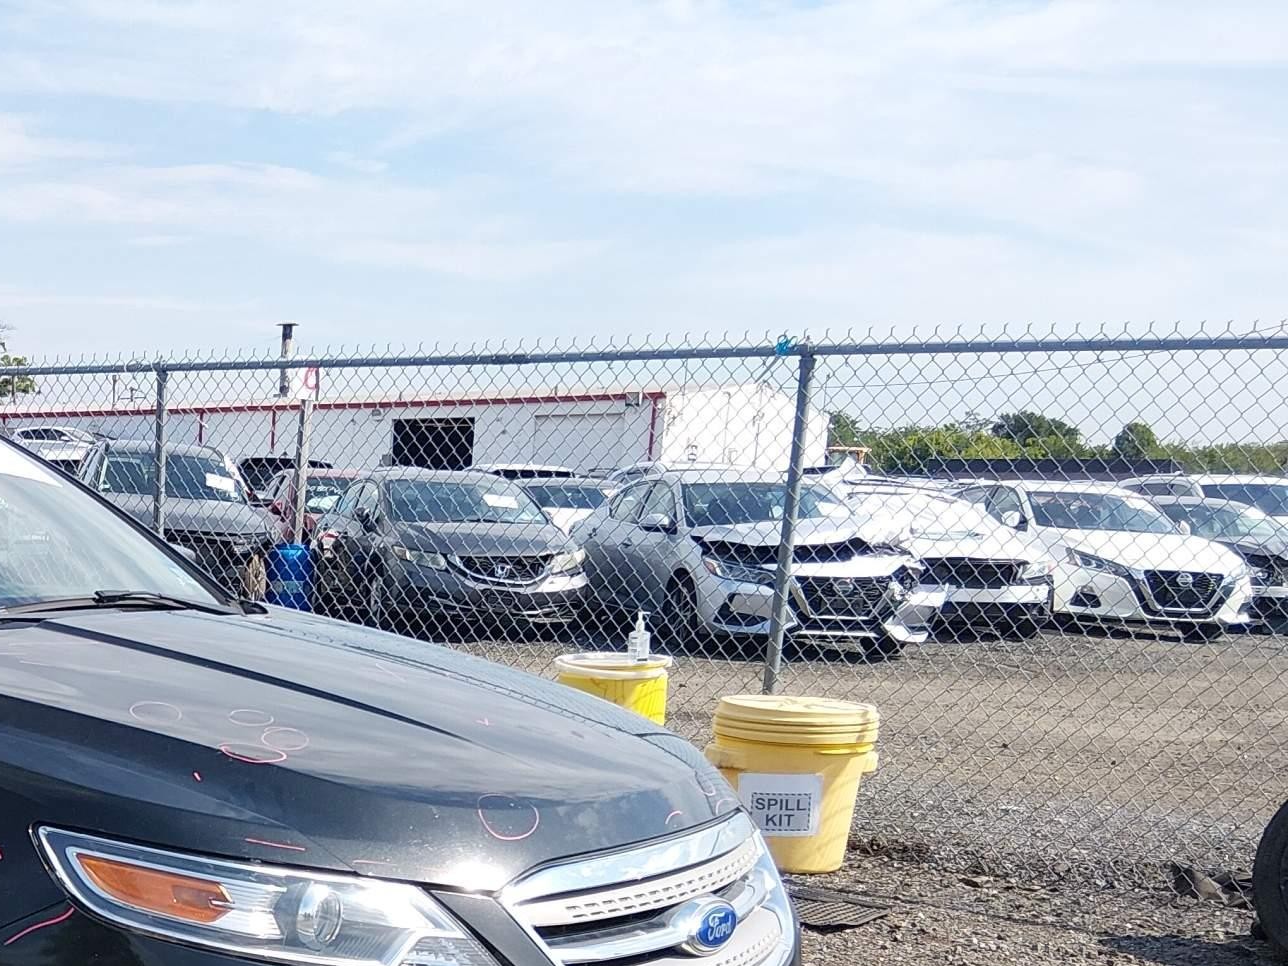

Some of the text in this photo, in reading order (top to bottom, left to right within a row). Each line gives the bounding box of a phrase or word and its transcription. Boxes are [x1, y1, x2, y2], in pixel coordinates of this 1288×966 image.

[755, 798, 807, 811] SPILL
[765, 813, 795, 827] KIT
[708, 911, 733, 941] Ford
